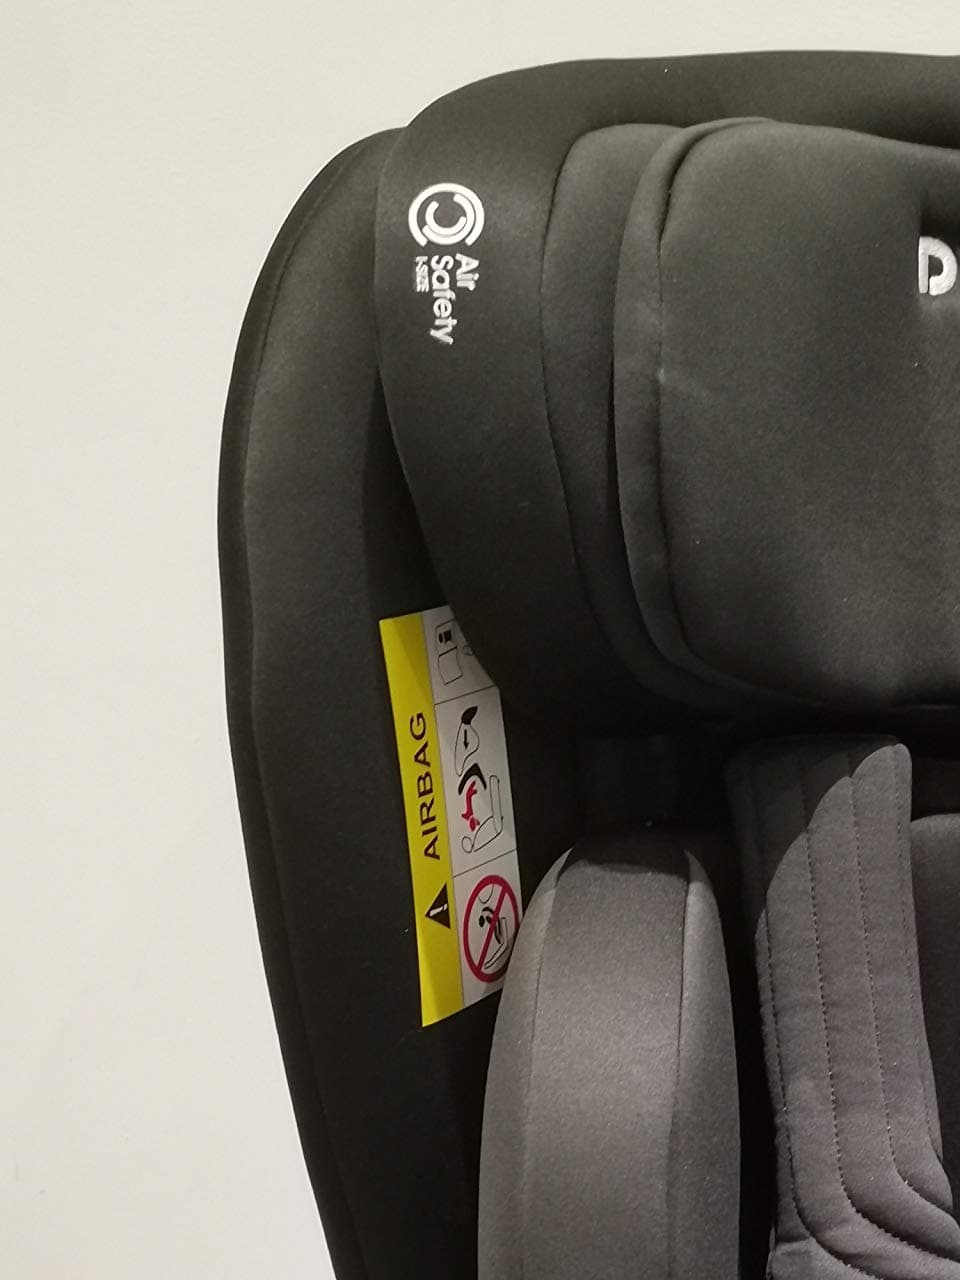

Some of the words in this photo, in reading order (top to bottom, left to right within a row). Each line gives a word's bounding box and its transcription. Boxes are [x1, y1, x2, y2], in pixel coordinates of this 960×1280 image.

[430, 255, 457, 344] Safety
[455, 253, 480, 291] Air
[409, 711, 441, 861] AIRBAG
